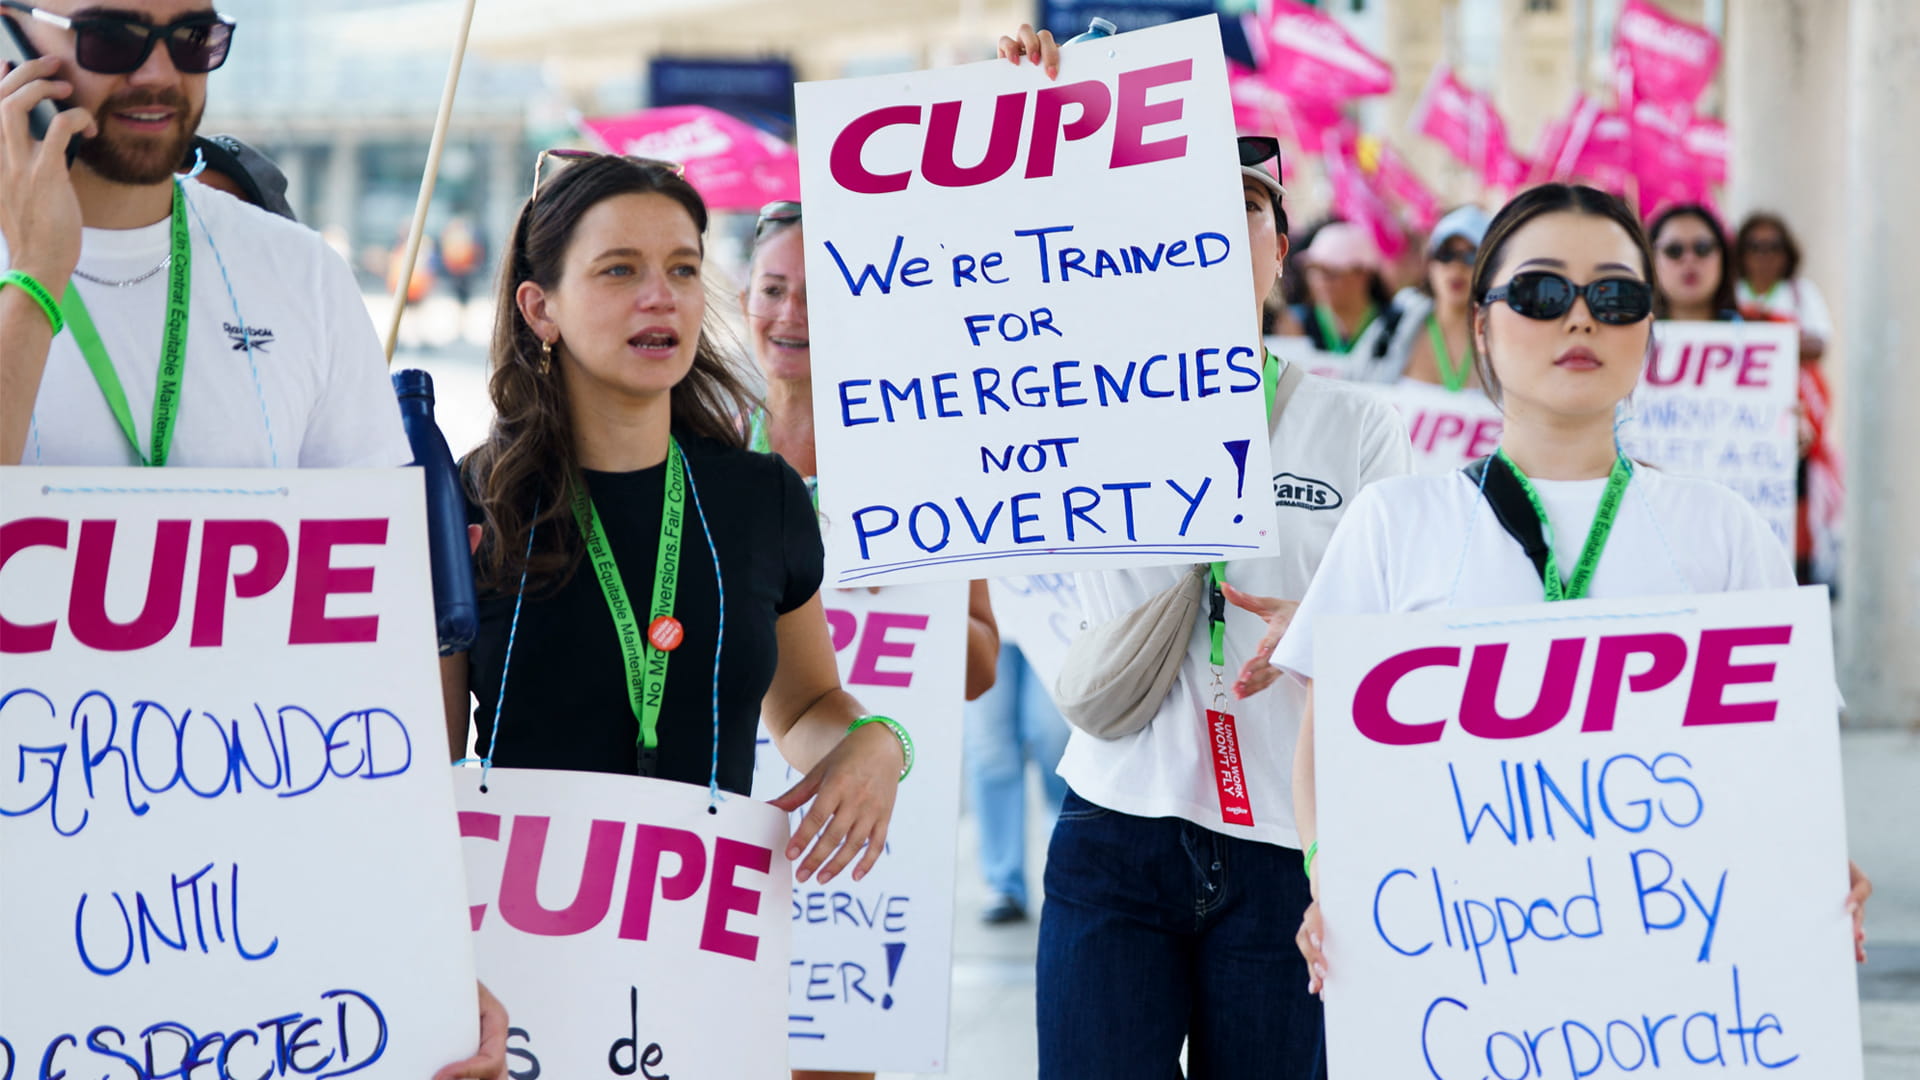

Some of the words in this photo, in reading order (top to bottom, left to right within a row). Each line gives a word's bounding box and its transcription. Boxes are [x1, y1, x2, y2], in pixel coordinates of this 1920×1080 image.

[829, 58, 1193, 194] CUPE
[964, 307, 1063, 346] FOR
[1645, 343, 1778, 387] UPE
[838, 346, 1262, 427] EMERGENCIES
[981, 437, 1079, 473] NOT
[0, 517, 389, 653] CUPE
[598, 560, 628, 620] Équitable
[646, 682, 662, 707] No
[1352, 624, 1793, 745] CUPE
[1214, 721, 1230, 768] WON'T
[1221, 769, 1235, 797] FLY
[1225, 724, 1237, 763] UNPAID
[1231, 766, 1244, 799] WORK
[1447, 752, 1704, 845] WINGS
[75, 862, 278, 976] UNTIL
[1630, 849, 1728, 962] By
[608, 985, 670, 1080] de
[1422, 964, 1799, 1080] Corporate
